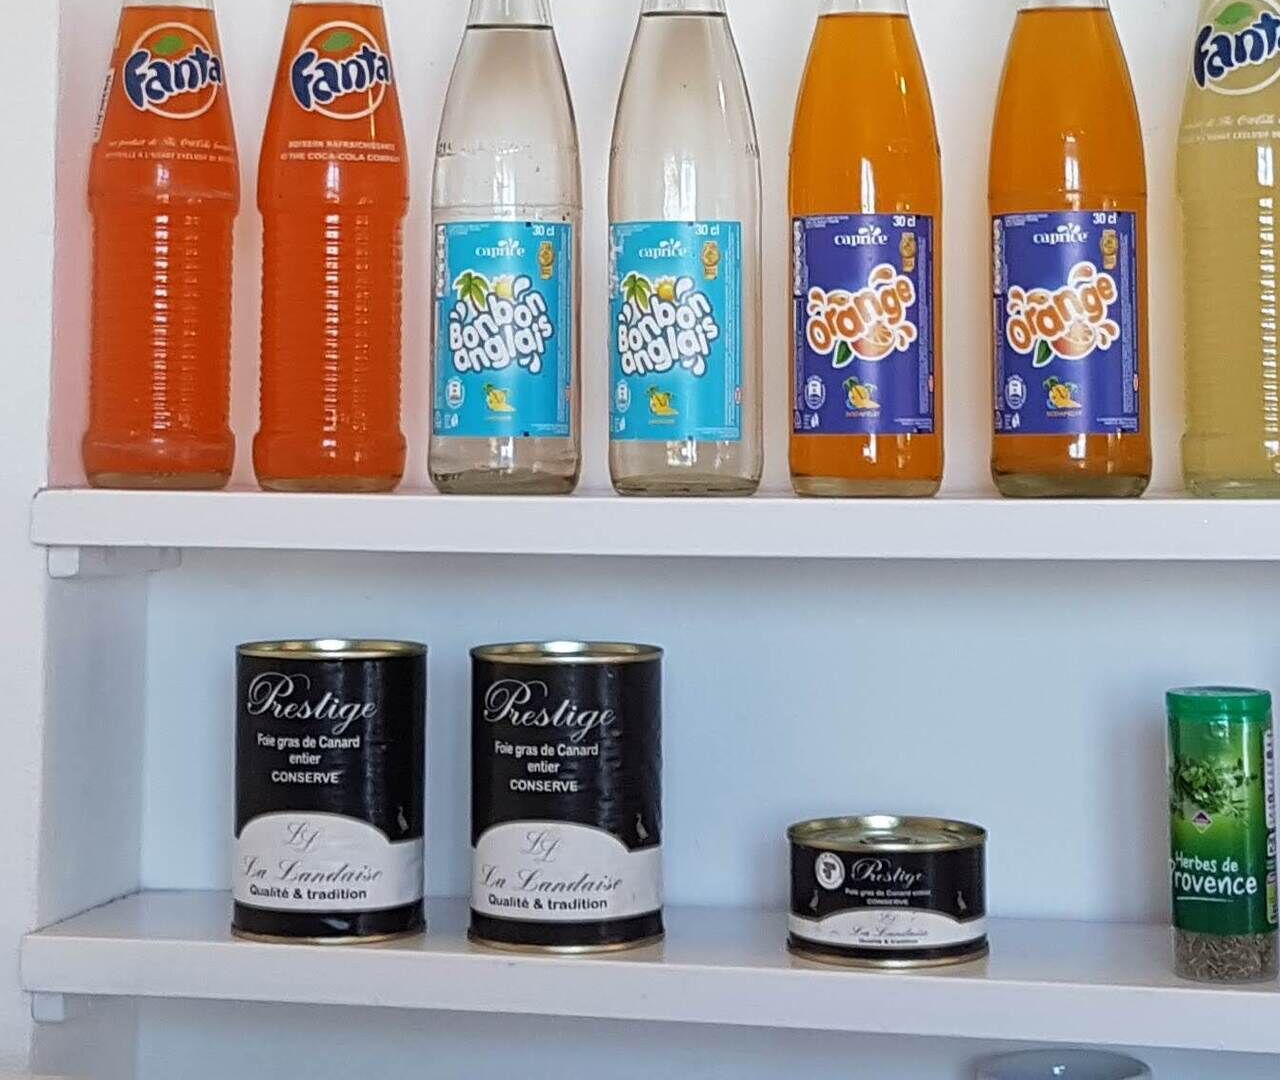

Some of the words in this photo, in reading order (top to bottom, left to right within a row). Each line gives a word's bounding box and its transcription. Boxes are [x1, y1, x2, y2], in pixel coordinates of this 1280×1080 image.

[125, 46, 221, 110] Fanta
[291, 44, 391, 110] Fanta
[307, 152, 365, 161] COCA-COLA
[893, 215, 906, 228] 30
[907, 215, 916, 228] cl
[1093, 213, 1106, 224] 30
[1108, 212, 1117, 224] cl
[533, 224, 547, 236] 30
[548, 224, 555, 237] cl
[695, 223, 710, 236] 30
[712, 223, 720, 236] cl
[1033, 230, 1088, 245] caprice
[834, 231, 888, 247] caprice
[475, 241, 526, 259] caprice
[638, 242, 688, 260] caprice
[449, 290, 547, 353] Bonbon
[618, 290, 712, 354] Bonbon
[453, 314, 553, 373] anglais
[620, 316, 719, 376] anglais
[247, 671, 377, 735] Prestige
[484, 679, 616, 742] Prestige
[257, 733, 276, 747] Foie
[277, 736, 300, 750] gras
[302, 735, 316, 748] de
[319, 735, 360, 748] Canard
[495, 740, 513, 754] Foie
[515, 744, 538, 758] gras
[540, 744, 555, 756] de
[557, 743, 598, 756] Canard
[289, 753, 321, 765] entier
[527, 761, 560, 773] entier
[271, 771, 339, 783] CONSERVE
[510, 779, 578, 792] CONSERVE
[244, 856, 269, 879] La
[1175, 851, 1217, 873] Herbes
[1222, 856, 1239, 872] de
[481, 864, 506, 889] La
[515, 869, 622, 893] Landaise
[851, 857, 922, 889] Prestige
[249, 884, 289, 899] Qualité
[293, 889, 303, 899] &
[307, 888, 367, 900] tradition
[488, 895, 529, 910] Qualité
[533, 899, 543, 909] &
[547, 898, 608, 910] tradition
